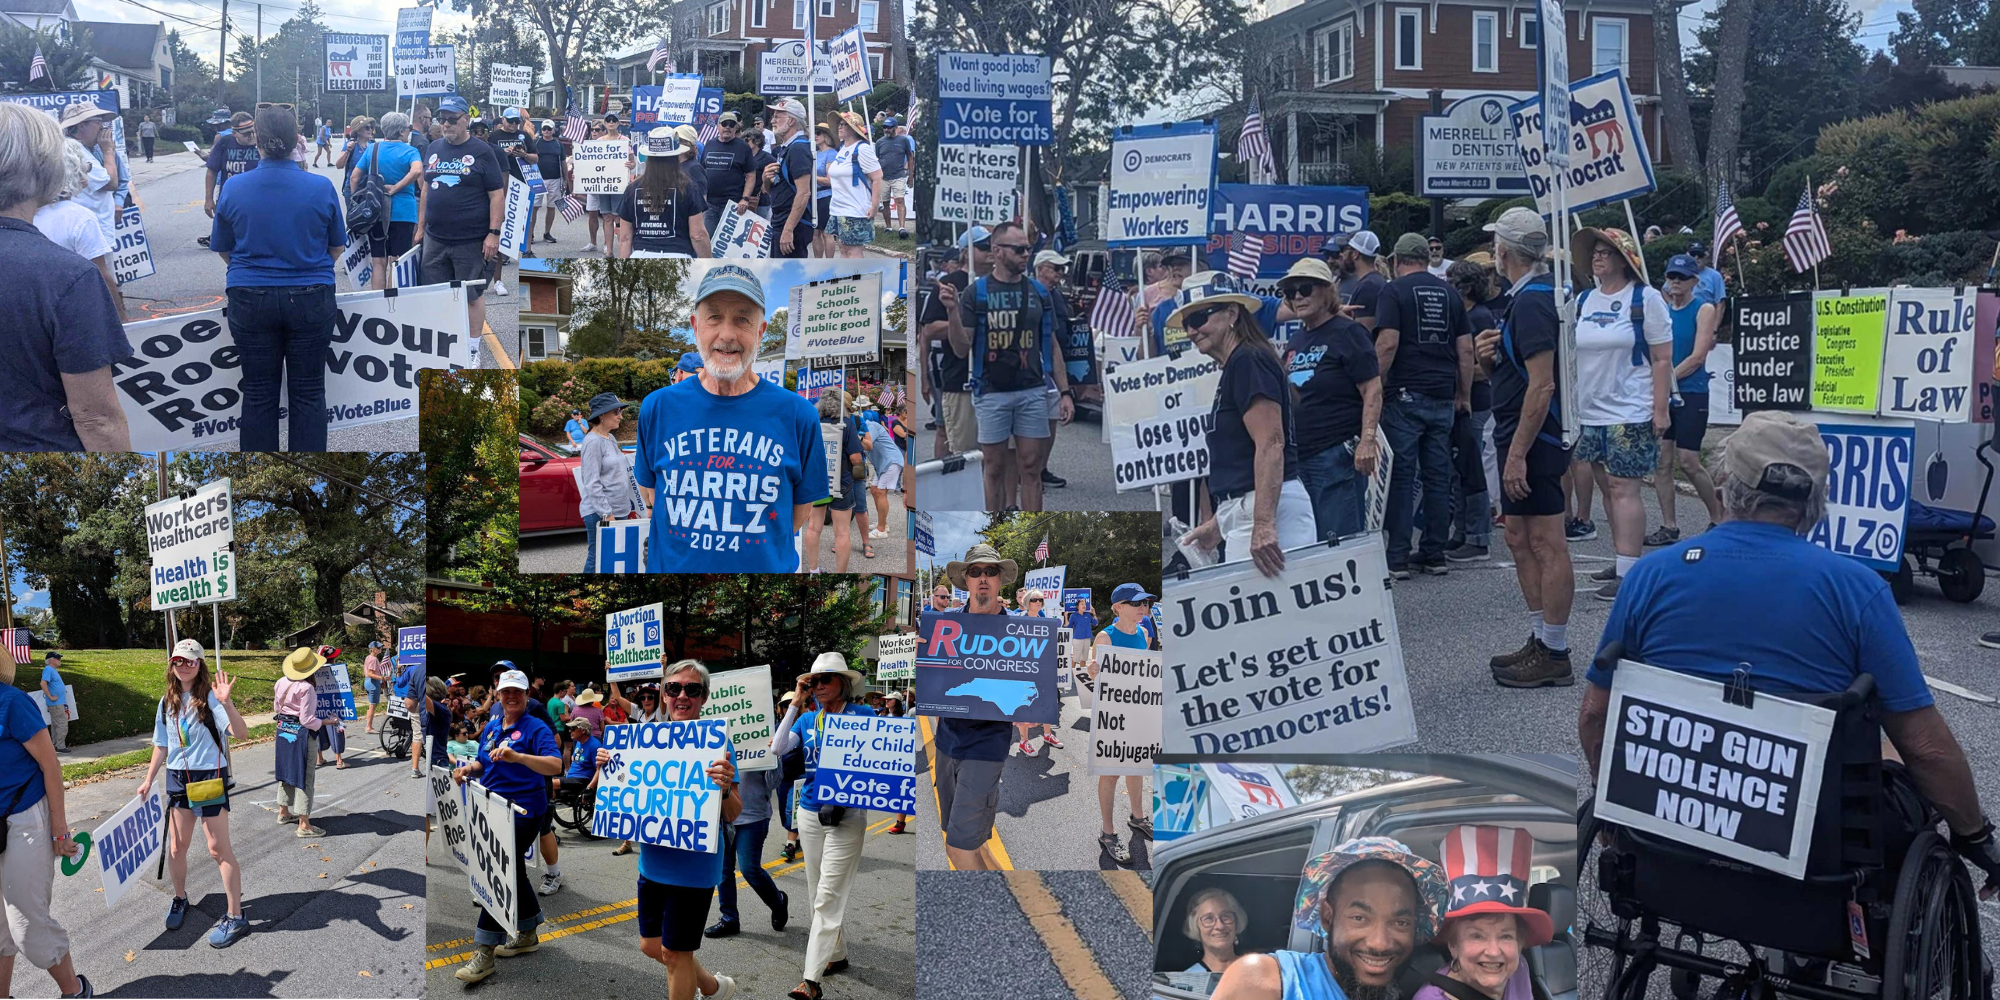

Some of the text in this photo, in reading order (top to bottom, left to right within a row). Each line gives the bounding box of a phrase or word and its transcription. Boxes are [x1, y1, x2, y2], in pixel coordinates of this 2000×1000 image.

[328, 35, 382, 45] DEMOCRATS
[398, 32, 423, 45] Vote for
[394, 46, 426, 56] Democrats
[436, 49, 446, 58] for
[830, 40, 844, 58] Proud
[419, 64, 448, 76] Security
[764, 58, 802, 66] MERRELL
[837, 59, 846, 72] be
[950, 56, 1041, 76] Want good jobs?
[368, 70, 382, 78] FAIR
[492, 76, 530, 84] Healthcare
[493, 68, 531, 78] Workers
[834, 71, 862, 92] Democrat
[330, 79, 382, 90] ELECTIONS
[403, 80, 408, 90] &
[493, 88, 528, 98] Health is
[940, 80, 1050, 98] Need living wages?
[71, 93, 100, 104] FOR
[493, 96, 520, 105] wealth
[660, 100, 695, 112] Empowering
[663, 112, 686, 122] Workers
[956, 102, 1037, 124] Vote for
[944, 118, 1050, 140] Democrats
[1430, 128, 1498, 140] MERRELL
[574, 150, 628, 162] Democrats
[580, 144, 620, 154] Vote for
[1144, 152, 1192, 164] DEMOCRATS
[1521, 132, 1586, 168] to a
[226, 162, 247, 172] NOT
[595, 165, 606, 174] or
[1436, 162, 1502, 170] NEW PATIENTS
[582, 175, 622, 184] mothers
[584, 183, 619, 193] will die
[998, 192, 1010, 206] is
[1109, 183, 1208, 211] Empowering
[500, 181, 521, 250] Democrats
[999, 207, 1008, 222] $
[1212, 204, 1363, 234] HARRIS
[1122, 216, 1189, 237] Workers
[346, 243, 371, 272] HOUSE
[821, 284, 856, 298] Public
[1245, 284, 1285, 298] Vote
[816, 296, 860, 310] Schools
[1816, 297, 1886, 316] U.S. Constitution
[808, 306, 868, 322] are for the
[987, 310, 1018, 330] NOT
[1740, 306, 1791, 330] Equal
[1895, 300, 1974, 336] Rule
[330, 312, 458, 358] your
[804, 318, 871, 335] public good
[1072, 324, 1088, 332] CALEB
[1816, 325, 1850, 338] Legislative
[807, 334, 865, 348] #VoteBlue
[1738, 334, 1800, 354] justice
[1826, 338, 1856, 350] Congress
[1816, 354, 1845, 366] Executive
[1916, 337, 1958, 374] of
[116, 346, 240, 407] Roe
[1738, 357, 1794, 378] under
[1824, 366, 1855, 377] President
[799, 369, 842, 390] HARRIS
[1110, 372, 1165, 394] Vote for
[1814, 382, 1838, 392] Judicial
[1164, 390, 1184, 409] or
[1737, 383, 1805, 404] the law
[1822, 393, 1864, 406] Federal courts
[1891, 376, 1968, 412] Law
[326, 396, 412, 424] #VoteBlue
[1135, 421, 1173, 450] lose
[664, 428, 784, 466] VETERANS
[706, 456, 734, 470] FOR
[630, 476, 644, 512] DEMOCRATS
[662, 470, 780, 502] HARRIS
[146, 492, 228, 534] Workers
[665, 498, 768, 533] WALZ
[150, 515, 230, 552] Healthcare
[690, 532, 740, 552] 2024
[154, 552, 229, 586] Health is
[156, 572, 228, 605] wealth $
[1024, 575, 1060, 592] HARRIS
[1172, 585, 1282, 638] Join
[1290, 559, 1362, 610] us!
[612, 608, 655, 628] Abortion
[402, 634, 426, 642] JEFF
[627, 630, 636, 644] is
[927, 620, 1049, 659] RUDOW
[1006, 623, 1050, 637] CALEB
[608, 648, 660, 666] Healthcare
[880, 660, 908, 670] Health
[1171, 618, 1385, 694] Let's get out
[880, 670, 910, 678] wealth
[964, 658, 1040, 674] CONGRESS
[332, 694, 346, 707] for
[1180, 658, 1381, 728] the vote for
[740, 714, 765, 726] the
[828, 716, 870, 732] Need
[1098, 710, 1125, 730] Not
[1190, 684, 1392, 754] Democrats!
[603, 719, 726, 750] DEMOCRATS
[732, 726, 770, 744] good
[826, 734, 866, 752] Early
[1625, 704, 1798, 778] STOP GUN
[602, 752, 625, 780] FOR
[628, 760, 718, 790] SOCIAL
[432, 774, 450, 799] Roe
[834, 773, 890, 794] Vote
[1624, 740, 1788, 816] VIOLENCE
[438, 797, 458, 822] Roe
[598, 786, 710, 820] SECURITY
[1654, 788, 1742, 840] NOW
[98, 794, 163, 872] HARRIS
[444, 824, 466, 846] Roe
[470, 792, 510, 878] your
[592, 816, 709, 851] MEDICARE
[114, 826, 160, 885] WALZ
[470, 874, 494, 908] #VoteBlue
